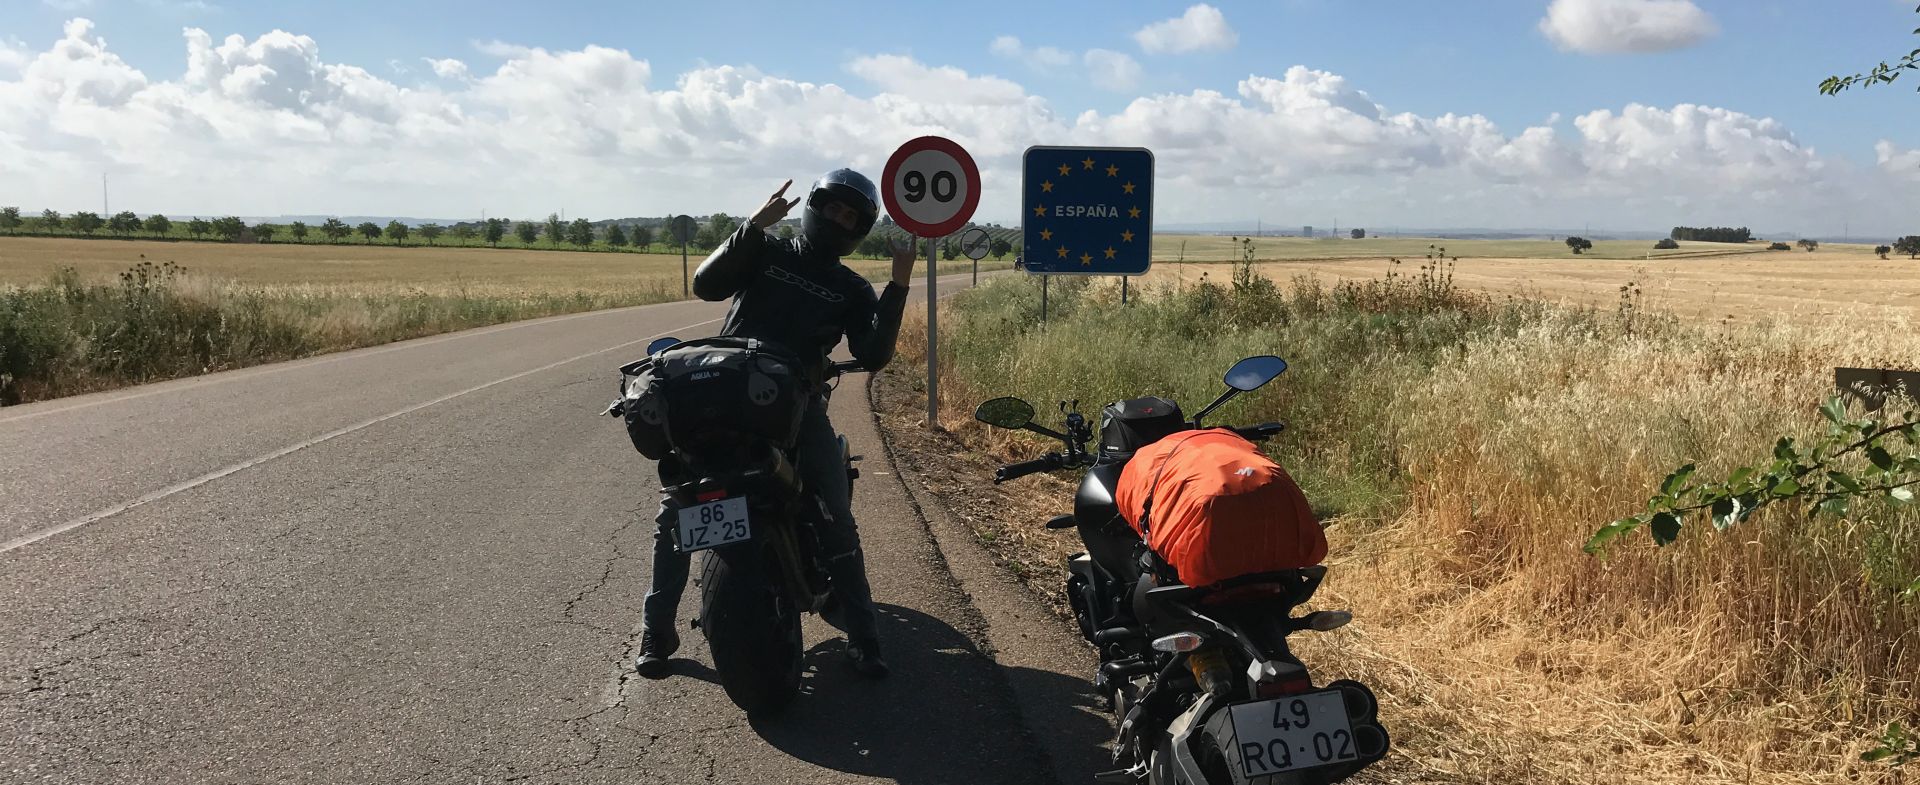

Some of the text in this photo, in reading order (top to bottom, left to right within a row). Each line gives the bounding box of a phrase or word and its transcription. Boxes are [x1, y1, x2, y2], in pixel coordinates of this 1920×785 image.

[903, 170, 957, 203] 90
[1055, 204, 1119, 218] ESPAÑA
[690, 371, 712, 381] AQUA
[700, 504, 724, 524] 86
[1273, 699, 1310, 731] 49
